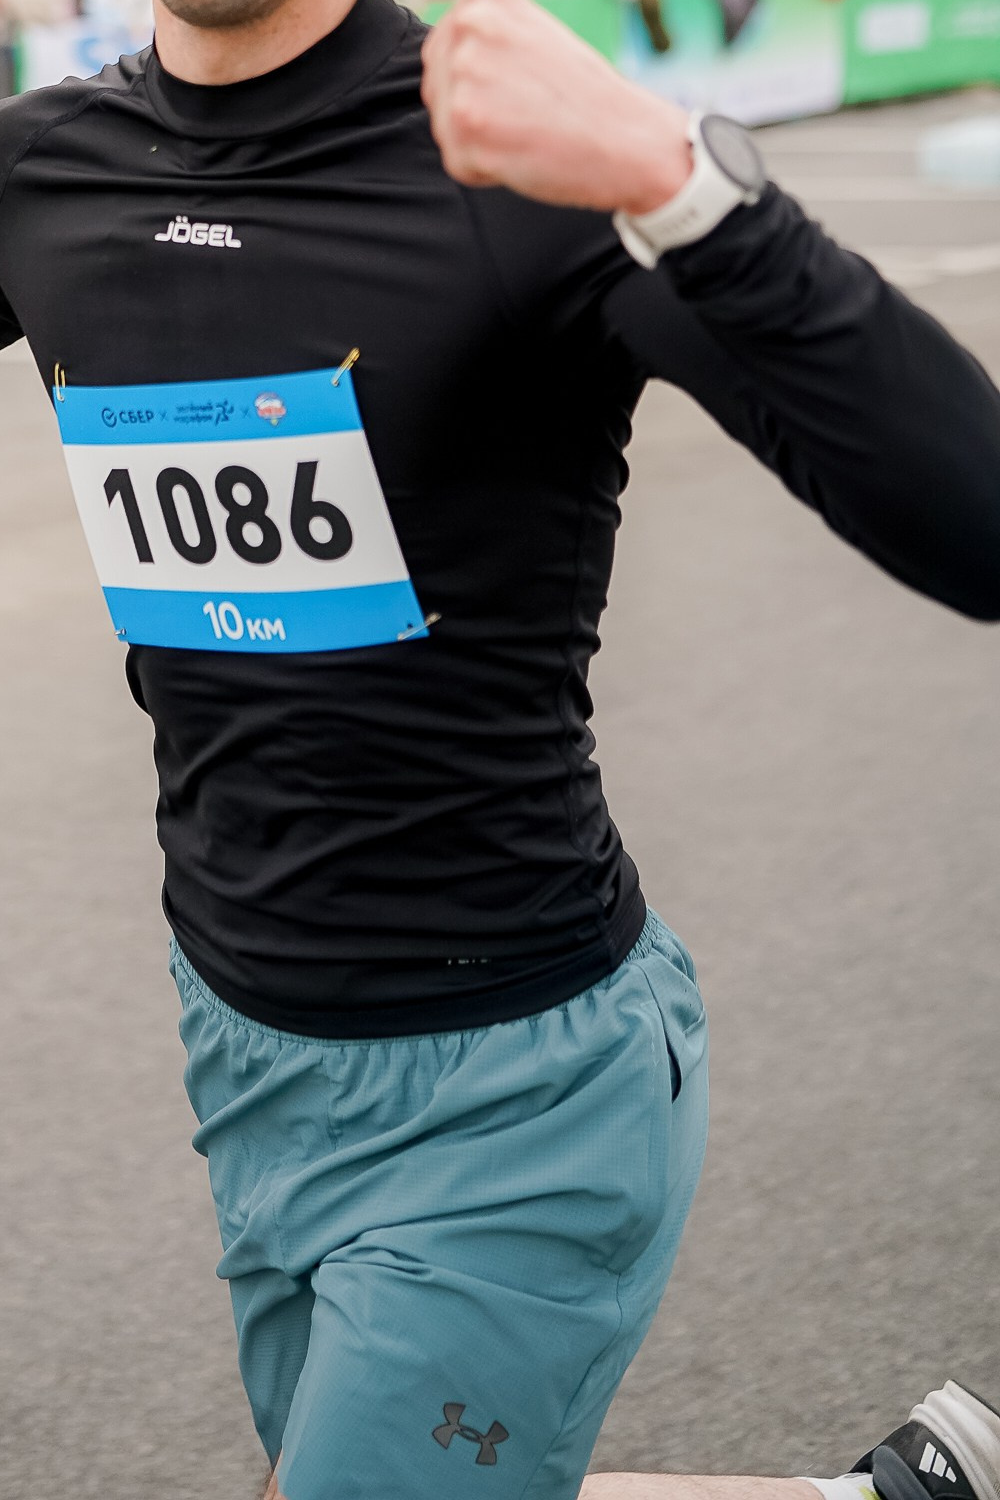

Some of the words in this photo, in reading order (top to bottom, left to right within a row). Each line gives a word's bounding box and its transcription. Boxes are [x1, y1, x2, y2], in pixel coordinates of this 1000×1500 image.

[154, 215, 242, 248] JÖGEL
[119, 410, 154, 424] СБЕР
[103, 460, 353, 565] 1086
[203, 601, 244, 640] 10
